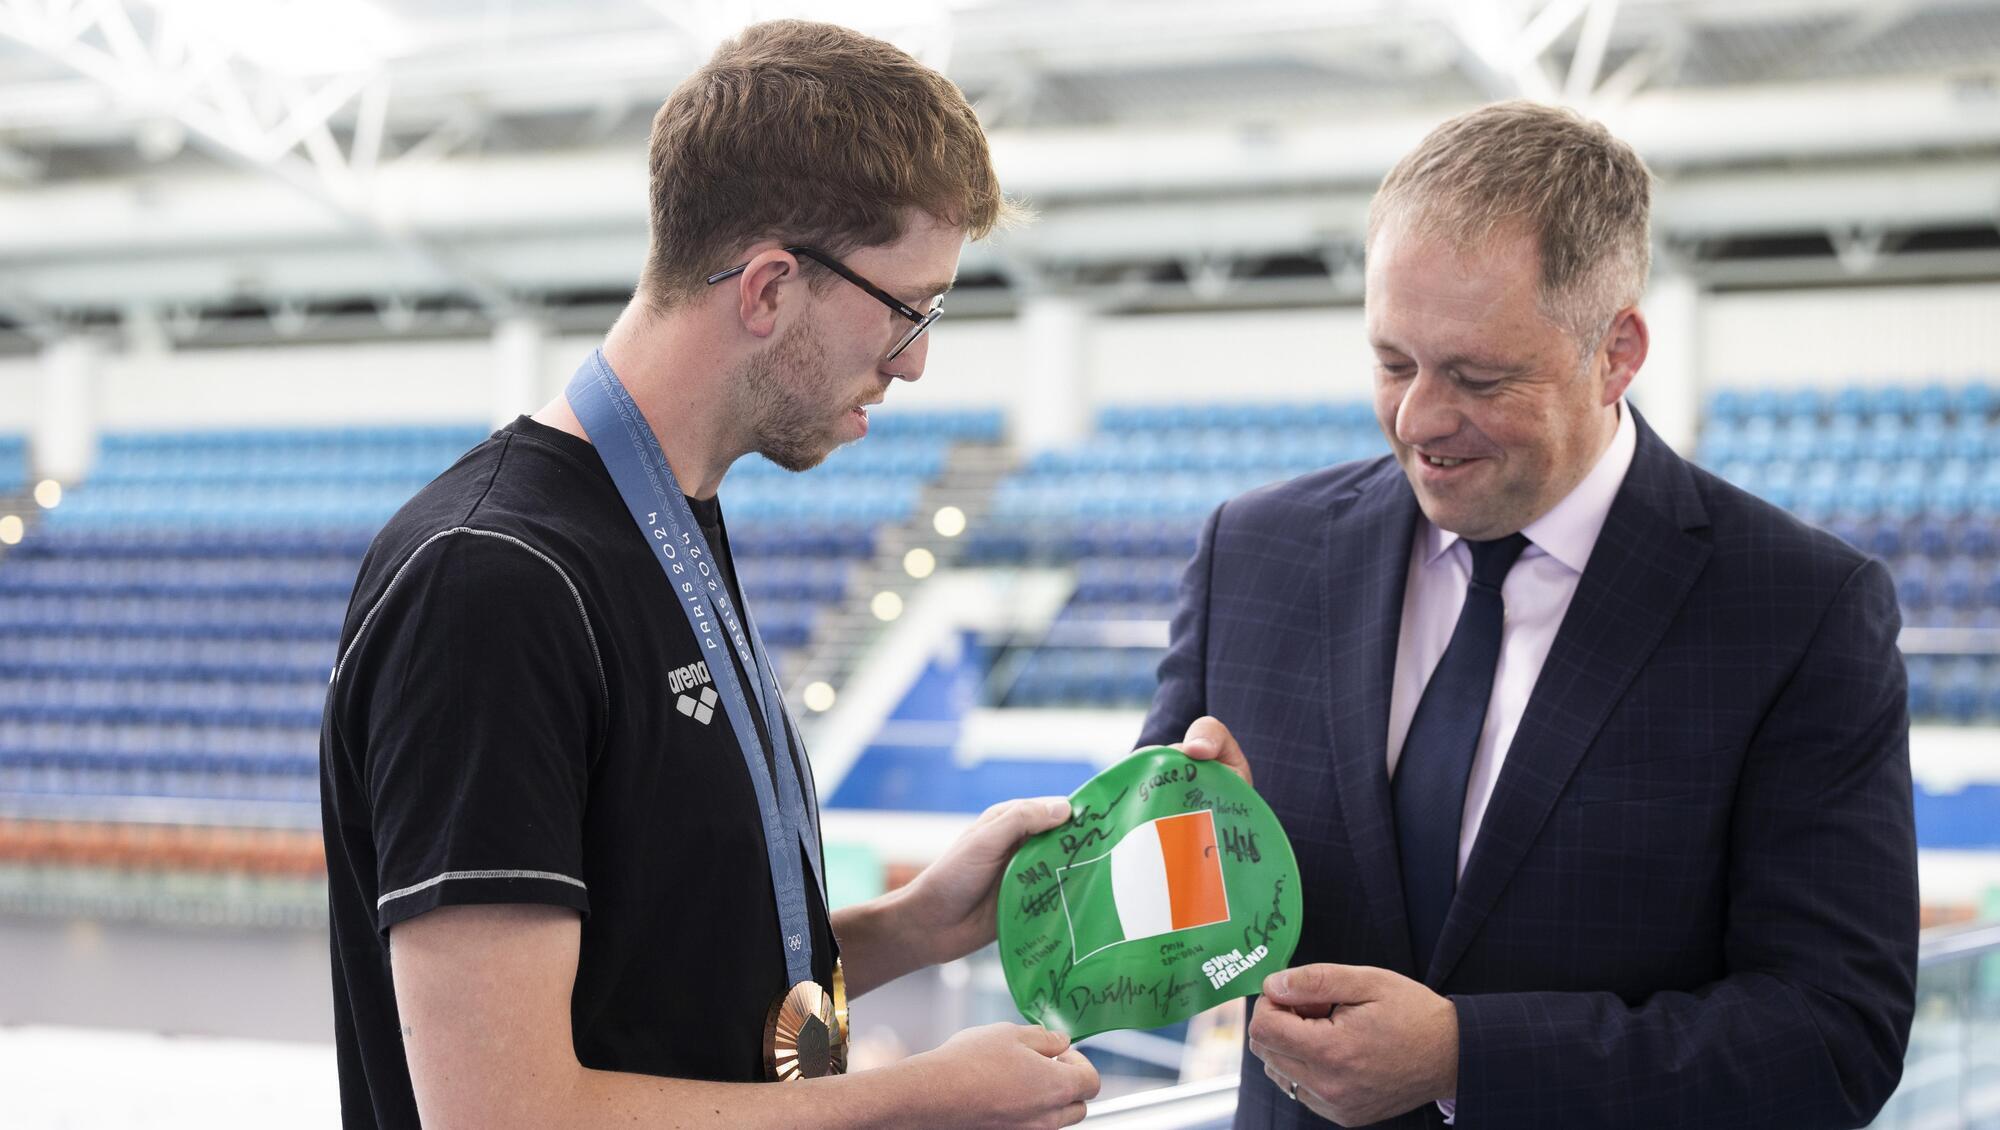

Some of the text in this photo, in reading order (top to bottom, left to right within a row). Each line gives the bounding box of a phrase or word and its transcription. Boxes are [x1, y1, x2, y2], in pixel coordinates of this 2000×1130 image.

[647, 511, 717, 649] PARIS 2024
[681, 532, 749, 661] PARIS 2024
[667, 660, 711, 694] arena
[1201, 948, 1243, 977] SWIM
[1209, 944, 1269, 990] IRELAND
